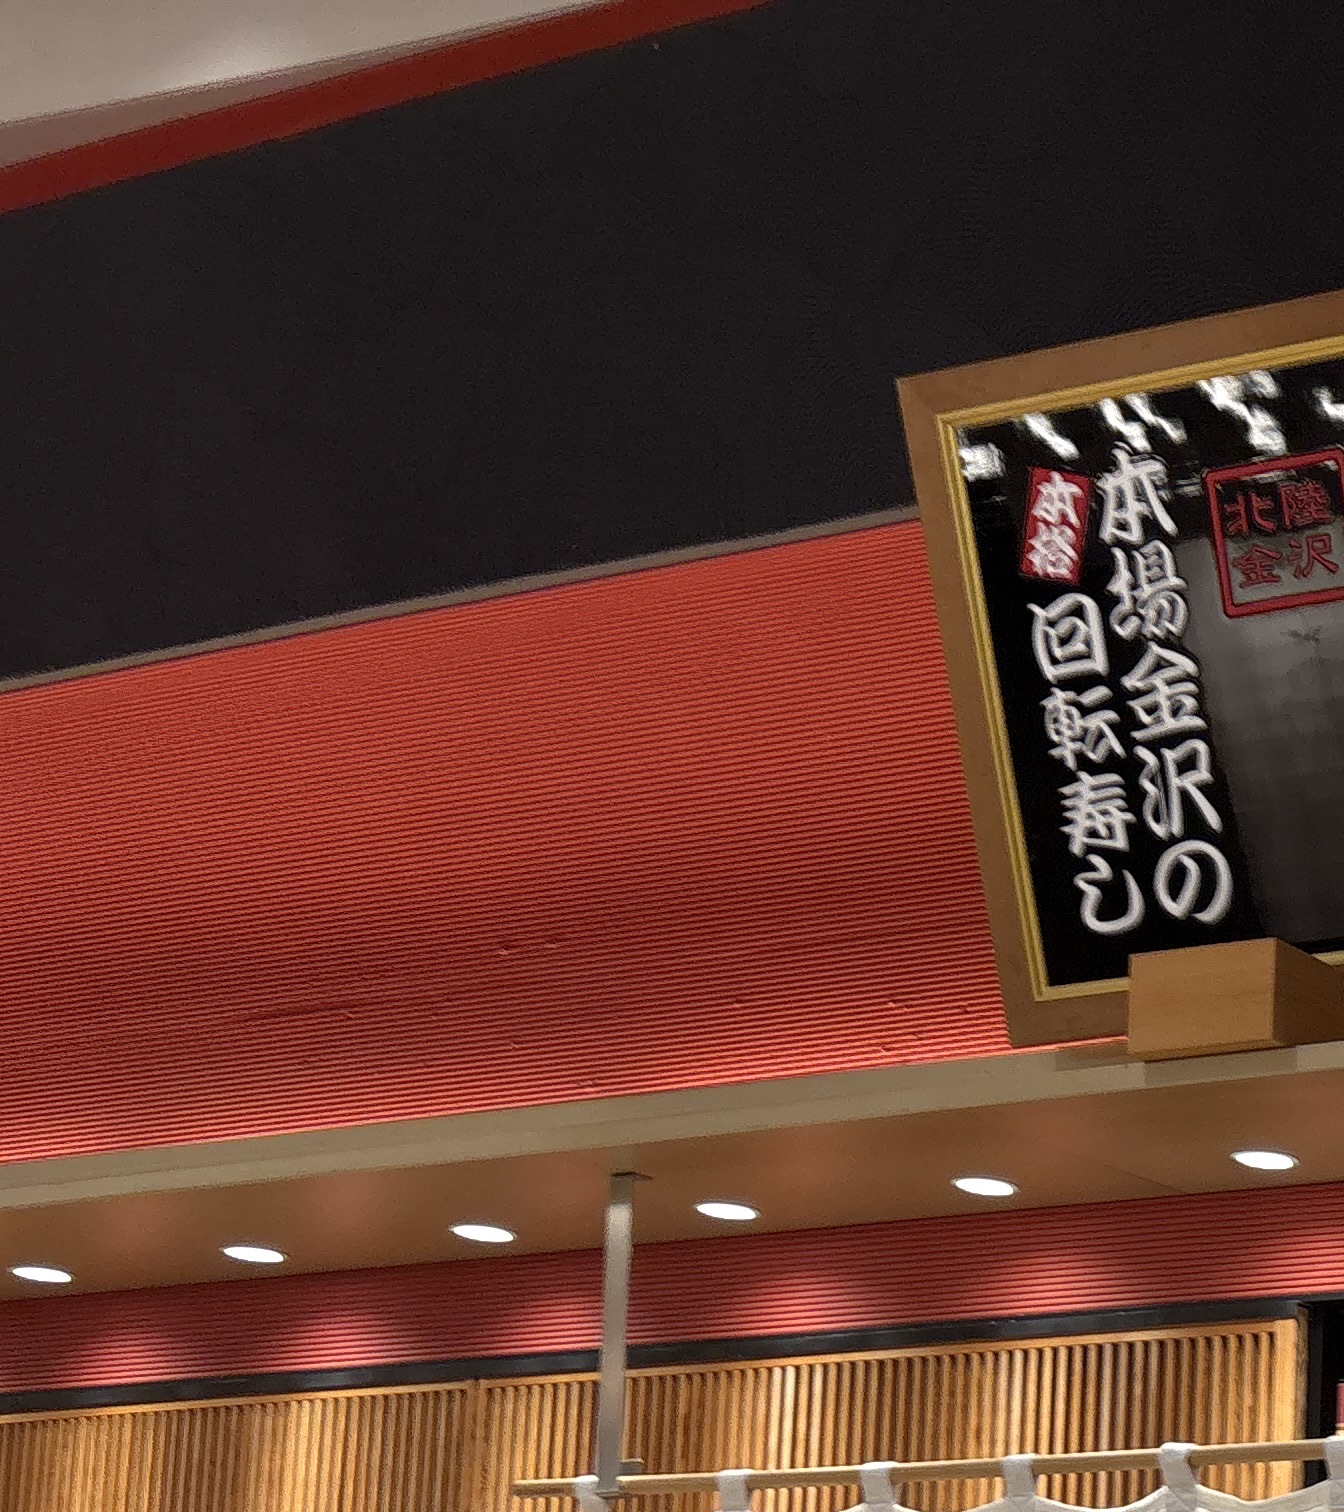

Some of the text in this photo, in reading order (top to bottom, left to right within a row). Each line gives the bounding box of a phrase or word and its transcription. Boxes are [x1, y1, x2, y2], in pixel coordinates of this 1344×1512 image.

[1224, 479, 1335, 536] 北陸
[1232, 533, 1339, 589] 金沢
[1027, 592, 1145, 935] 回転寿し
[1099, 440, 1233, 926] 本場金沢の
